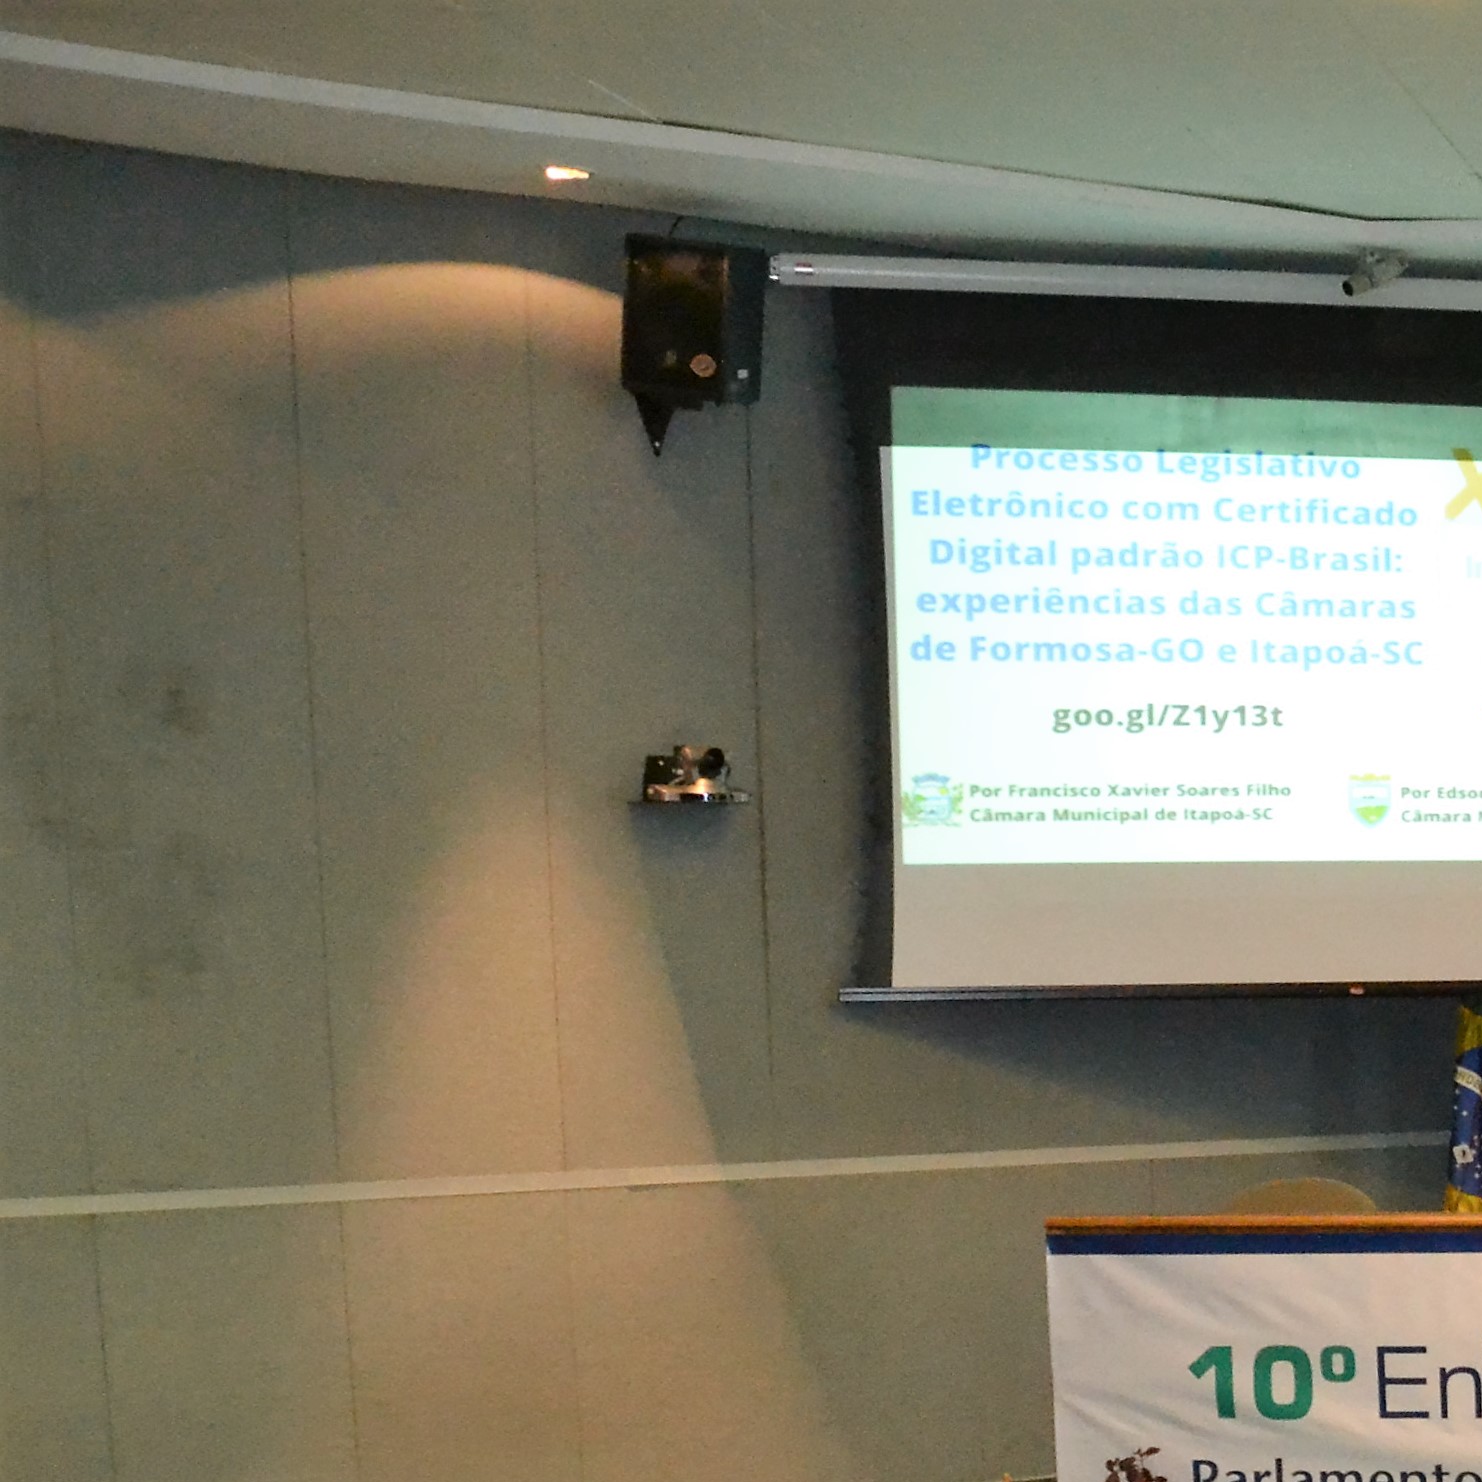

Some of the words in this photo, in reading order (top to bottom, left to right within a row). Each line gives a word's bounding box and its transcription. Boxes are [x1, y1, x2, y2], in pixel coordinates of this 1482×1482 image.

[970, 444, 1143, 473] Processo
[1157, 449, 1361, 482] Legislativo
[911, 490, 1108, 519] Eletrônico
[1122, 500, 1200, 521] com
[1213, 498, 1418, 527] Certificado
[930, 539, 1057, 573] Digital
[1071, 542, 1204, 574] padrão
[1217, 544, 1403, 573] ICP-Brasil:
[916, 588, 1166, 621] experiências
[1178, 590, 1242, 617] das
[1256, 590, 1416, 619] Câmaras
[910, 635, 956, 662] de
[970, 636, 1204, 662] Formosa-GO
[1218, 642, 1237, 663] e
[1251, 640, 1424, 671] Itapoá-SC
[1052, 703, 1283, 734] goo.gl/Z1y13t
[970, 784, 1002, 797] Por
[1009, 784, 1100, 797] Francisco
[1108, 784, 1170, 797] Xavier
[1177, 785, 1240, 797] Soares
[1247, 784, 1291, 797] Filho
[1401, 787, 1430, 799] Por
[970, 808, 1046, 822] Câmara
[1053, 808, 1147, 824] Municipal
[1155, 808, 1176, 821] de
[1184, 808, 1273, 823] Itapoá-SC
[1401, 811, 1472, 823] Câmara
[1187, 1342, 1356, 1421] 10º
